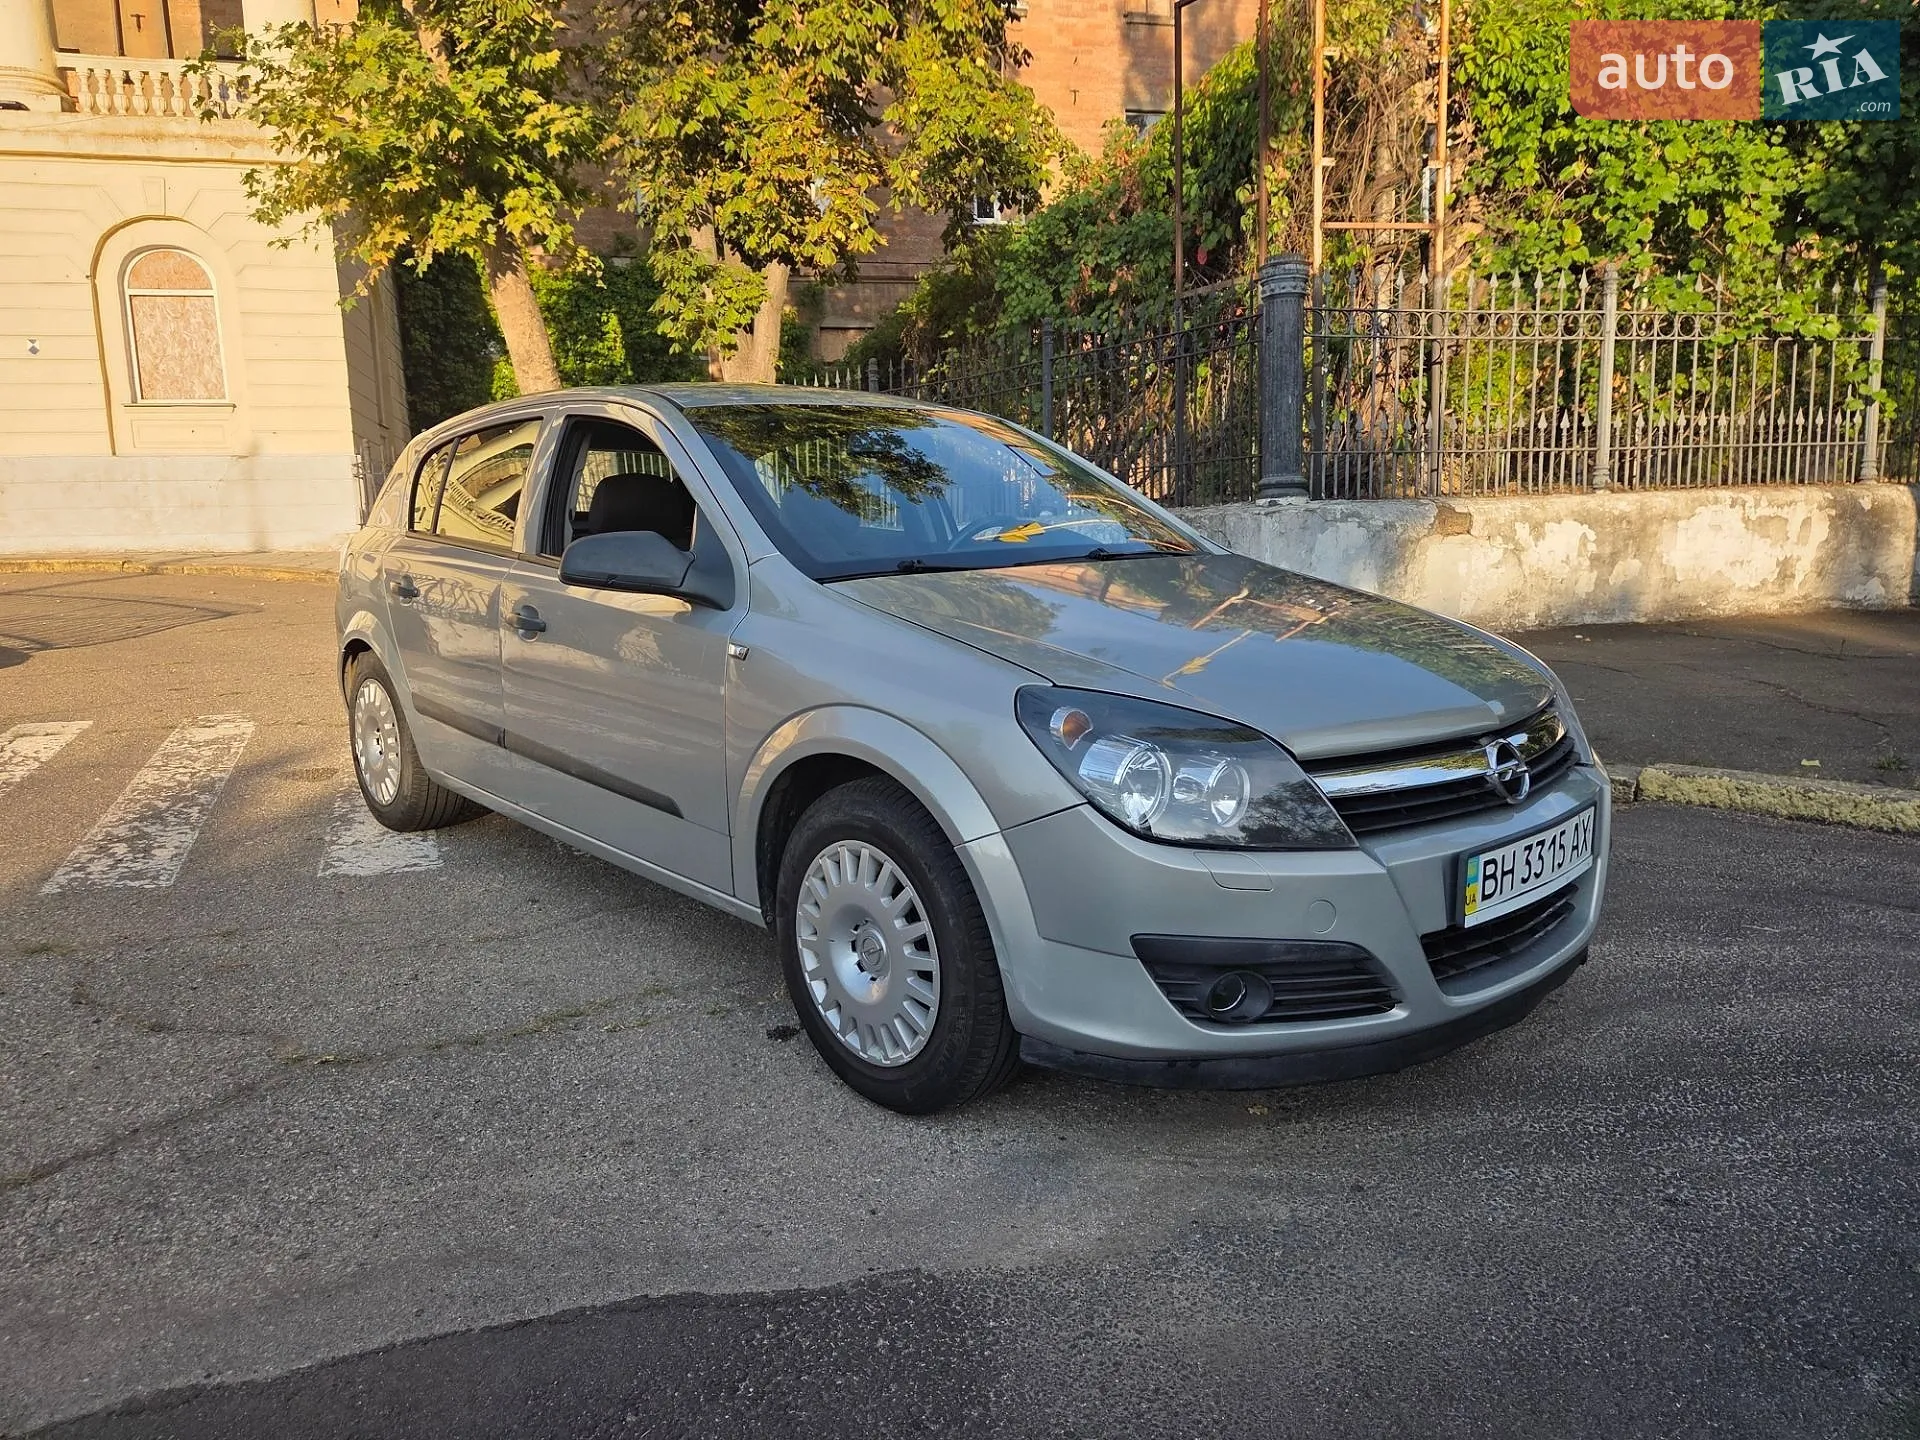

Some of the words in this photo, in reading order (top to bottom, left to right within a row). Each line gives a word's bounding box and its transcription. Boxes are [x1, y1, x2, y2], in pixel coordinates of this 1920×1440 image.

[1481, 850, 1516, 902] BH
[1521, 830, 1566, 884] 3315
[1570, 814, 1591, 862] AX
[1465, 894, 1477, 906] UA
